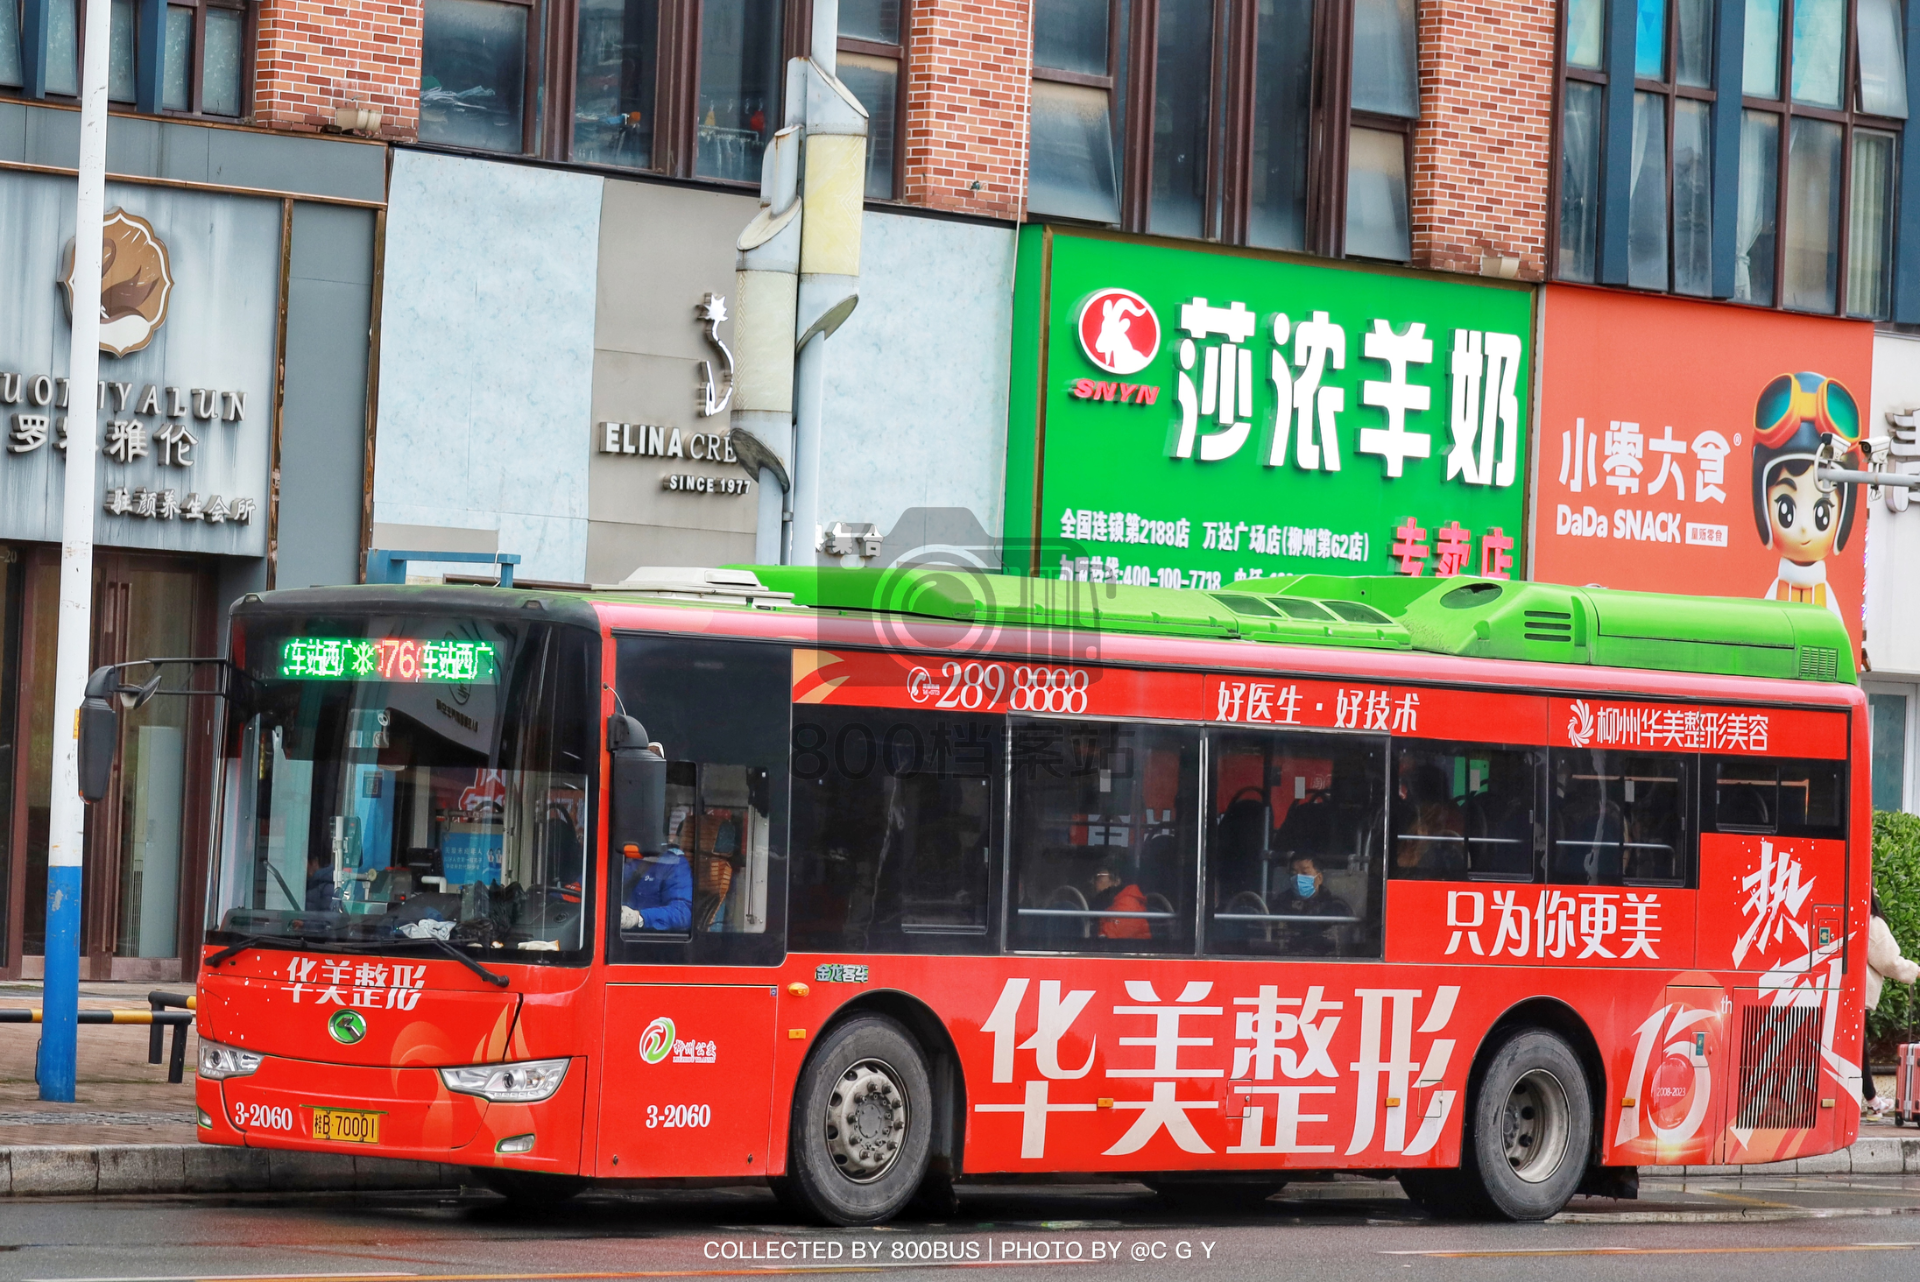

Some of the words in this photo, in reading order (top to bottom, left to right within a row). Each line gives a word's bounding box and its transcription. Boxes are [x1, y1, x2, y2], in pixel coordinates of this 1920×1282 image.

[1072, 378, 1160, 405] SNYN
[1171, 297, 1522, 487] 莎浓羊奶
[12, 413, 198, 467] 罗雅伦
[604, 422, 684, 458] ELINA
[1558, 417, 1731, 505] 小零大食
[669, 475, 714, 493] SINCE
[720, 477, 751, 494] 1977
[1060, 507, 1191, 549] 全国连锁第2188店
[1556, 504, 1608, 538] DaDa
[1612, 508, 1682, 544] SNACK
[1597, 706, 1769, 751] 柳州华美整形美容
[1444, 889, 1662, 960] 只为你更美
[281, 956, 427, 1011] 华美整形
[815, 963, 869, 983] 金龙客车
[974, 977, 1461, 1158] 华美整形
[1656, 1087, 1686, 1098] 2008-2023
[235, 1102, 293, 1131] 3-2060
[645, 1104, 711, 1129] 3-2060
